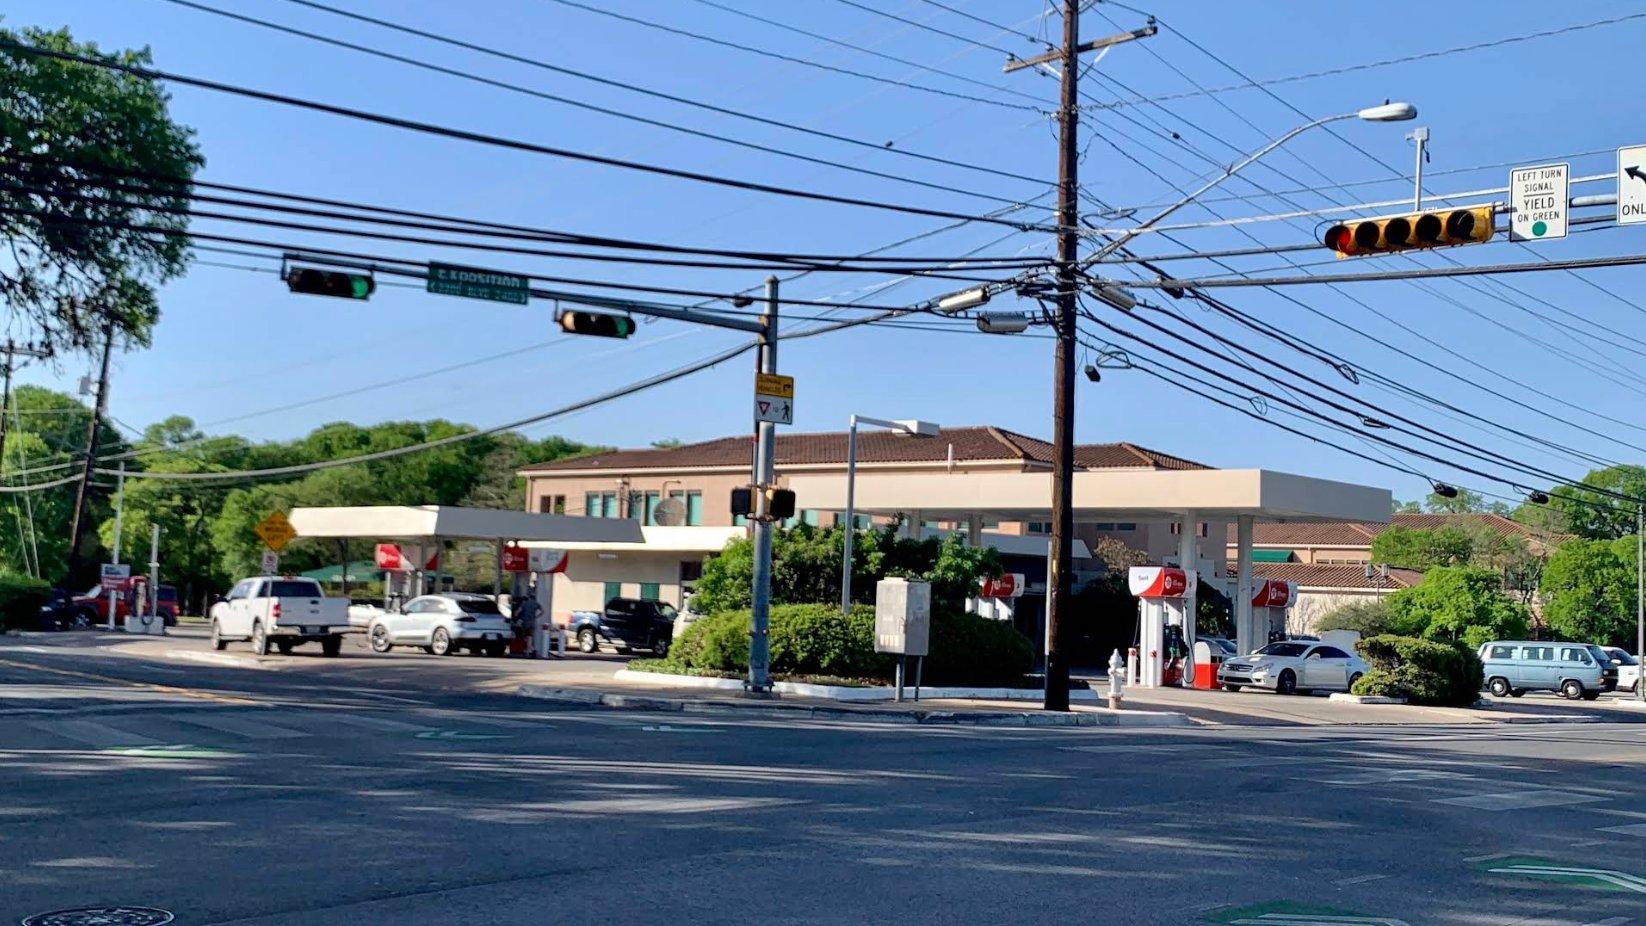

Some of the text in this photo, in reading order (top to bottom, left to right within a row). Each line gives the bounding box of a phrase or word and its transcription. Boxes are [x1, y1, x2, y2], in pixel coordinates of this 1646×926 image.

[1517, 169, 1562, 182] LEFT TURN
[1524, 182, 1554, 193] SIGNAL
[1523, 197, 1555, 210] YIELD
[1622, 203, 1646, 216] ONL
[1517, 211, 1560, 223] ON GREEN
